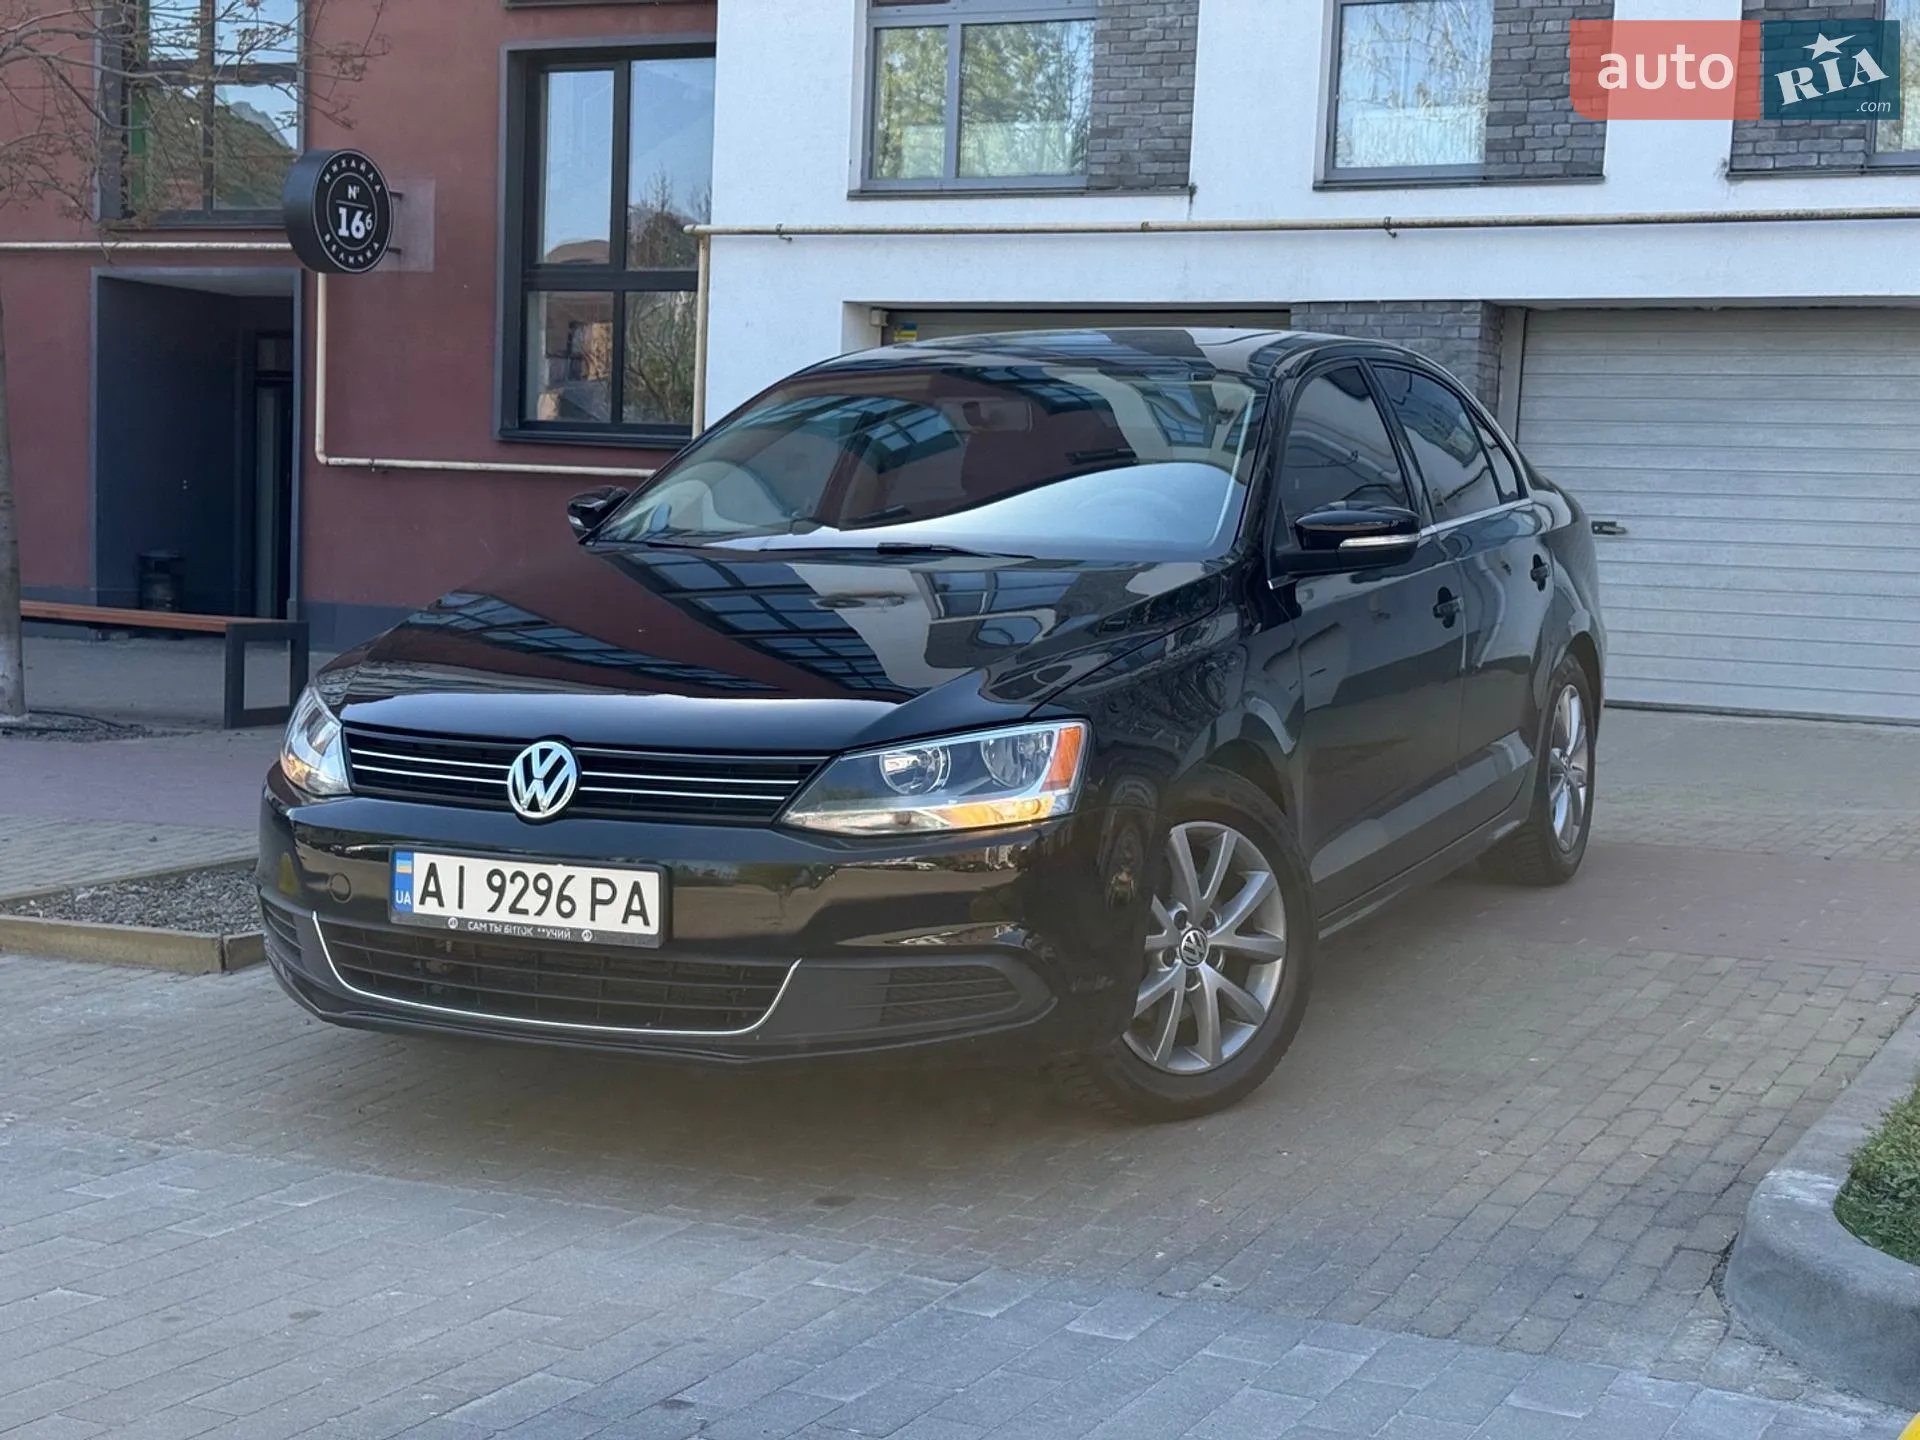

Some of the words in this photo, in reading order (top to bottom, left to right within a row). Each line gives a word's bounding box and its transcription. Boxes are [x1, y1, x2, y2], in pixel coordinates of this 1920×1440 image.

[395, 889, 412, 906] UA
[418, 861, 466, 910] AI
[486, 868, 577, 920] 9296
[590, 876, 651, 928] PA
[467, 921, 488, 933] САМ
